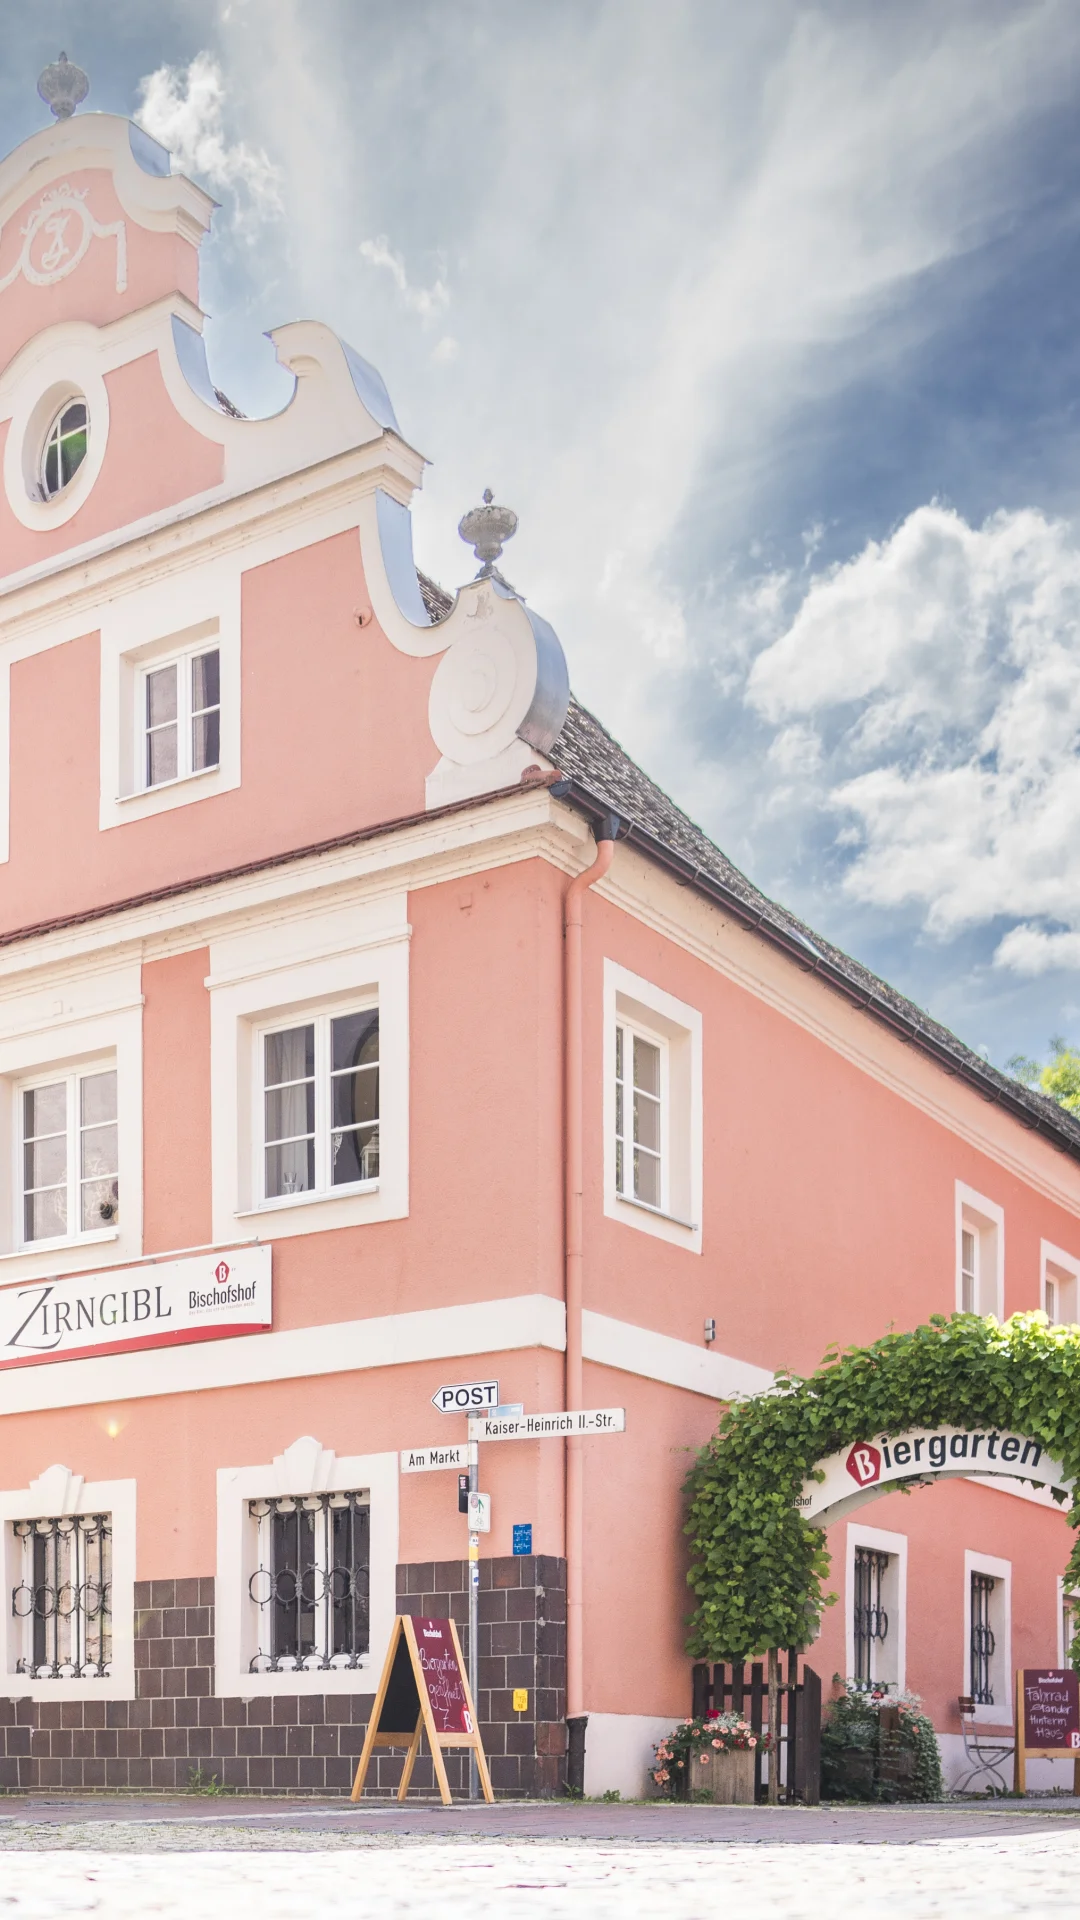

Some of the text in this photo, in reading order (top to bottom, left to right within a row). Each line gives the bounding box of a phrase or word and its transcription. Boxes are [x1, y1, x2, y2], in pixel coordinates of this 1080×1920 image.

[189, 1280, 256, 1309] Bischofshof
[5, 1286, 172, 1349] ZIRNGIBL
[442, 1386, 496, 1408] POST
[485, 1414, 616, 1435] Kaiser-Heinrich II.-Str.
[408, 1449, 460, 1467] Am Markt
[854, 1431, 1043, 1481] Biergarten
[1026, 1686, 1068, 1702] Fahrrad
[1029, 1715, 1067, 1726] Hinterm
